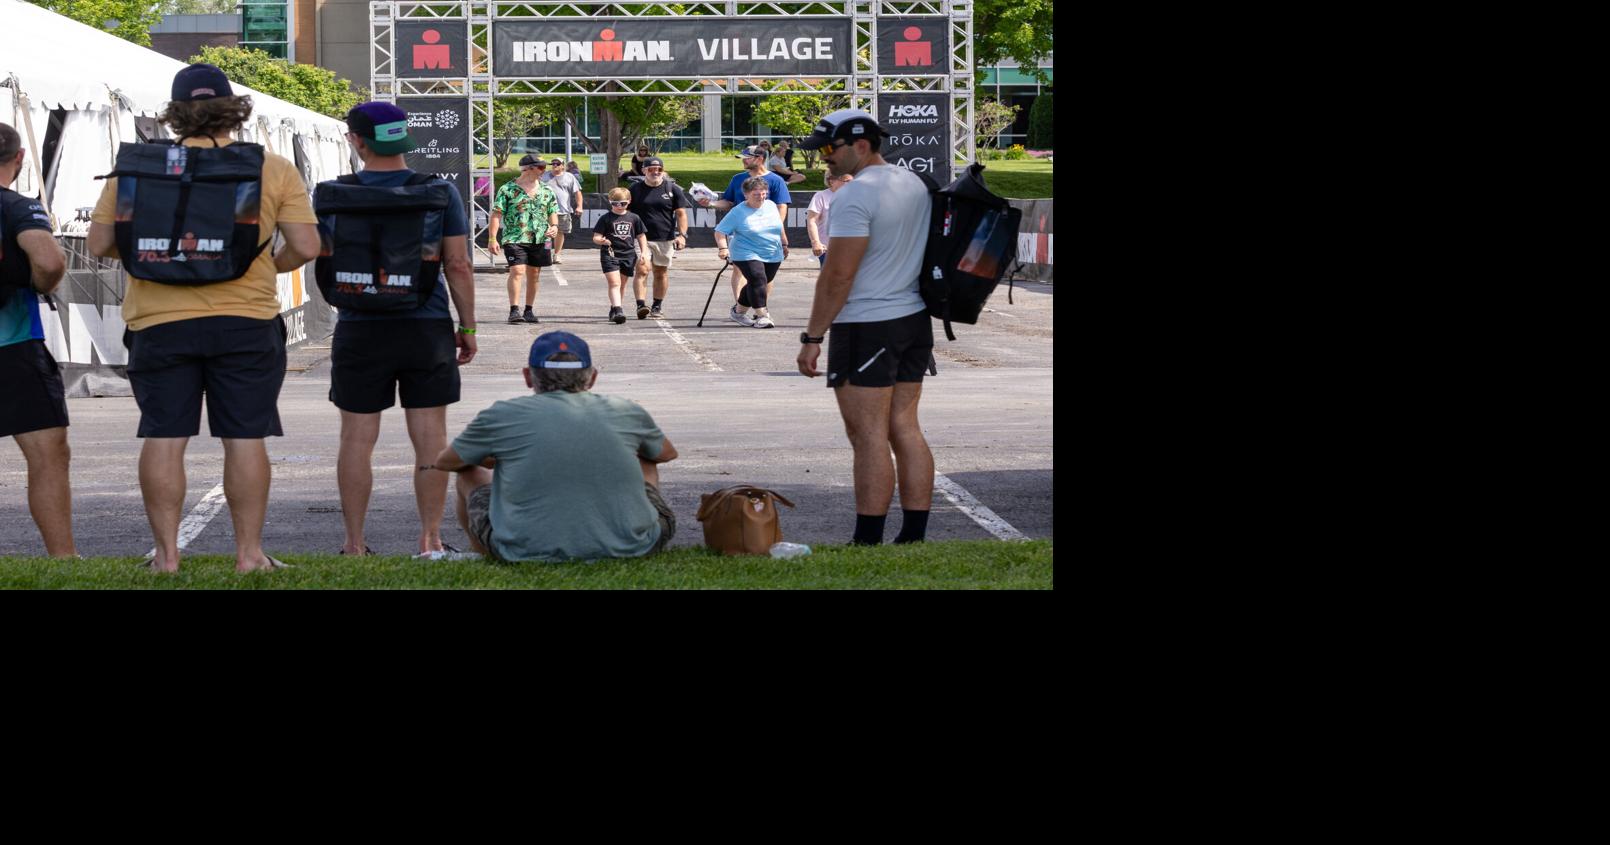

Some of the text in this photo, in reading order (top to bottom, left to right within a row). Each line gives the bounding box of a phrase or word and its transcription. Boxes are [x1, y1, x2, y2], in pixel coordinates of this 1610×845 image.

[697, 37, 833, 61] VILLAGE
[888, 104, 939, 117] HOKA
[896, 157, 935, 174] AG1
